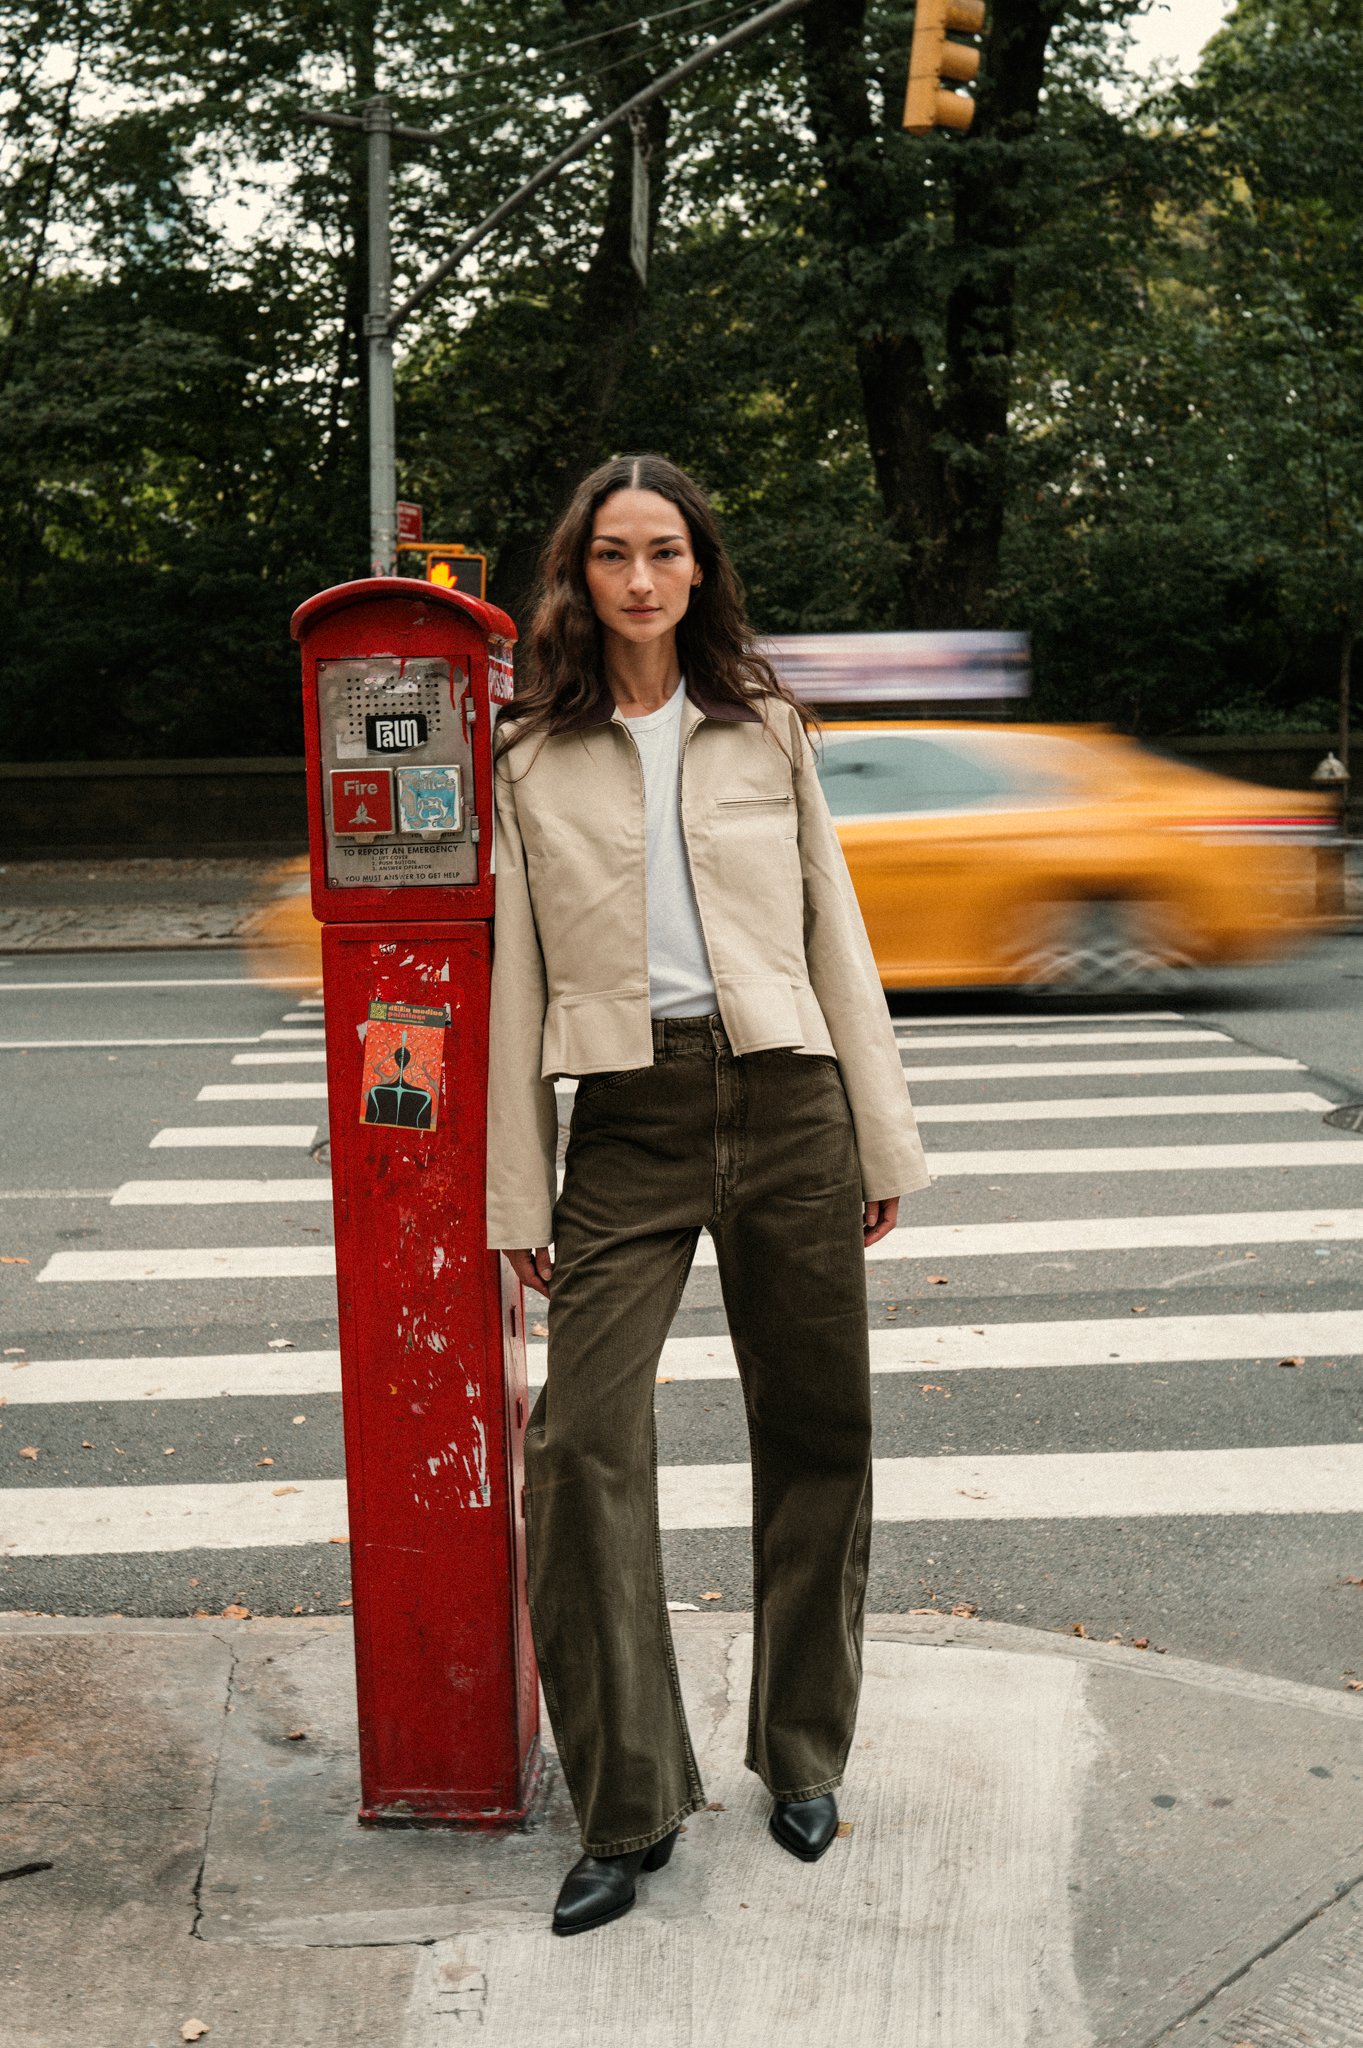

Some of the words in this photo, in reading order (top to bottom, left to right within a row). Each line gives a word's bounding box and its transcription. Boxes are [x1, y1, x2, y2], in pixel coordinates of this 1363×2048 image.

[343, 779, 379, 796] Fire
[358, 847, 389, 856] REPORT
[391, 846, 405, 855] AN
[407, 845, 458, 854] EMERGENCY
[362, 874, 381, 882] MUST
